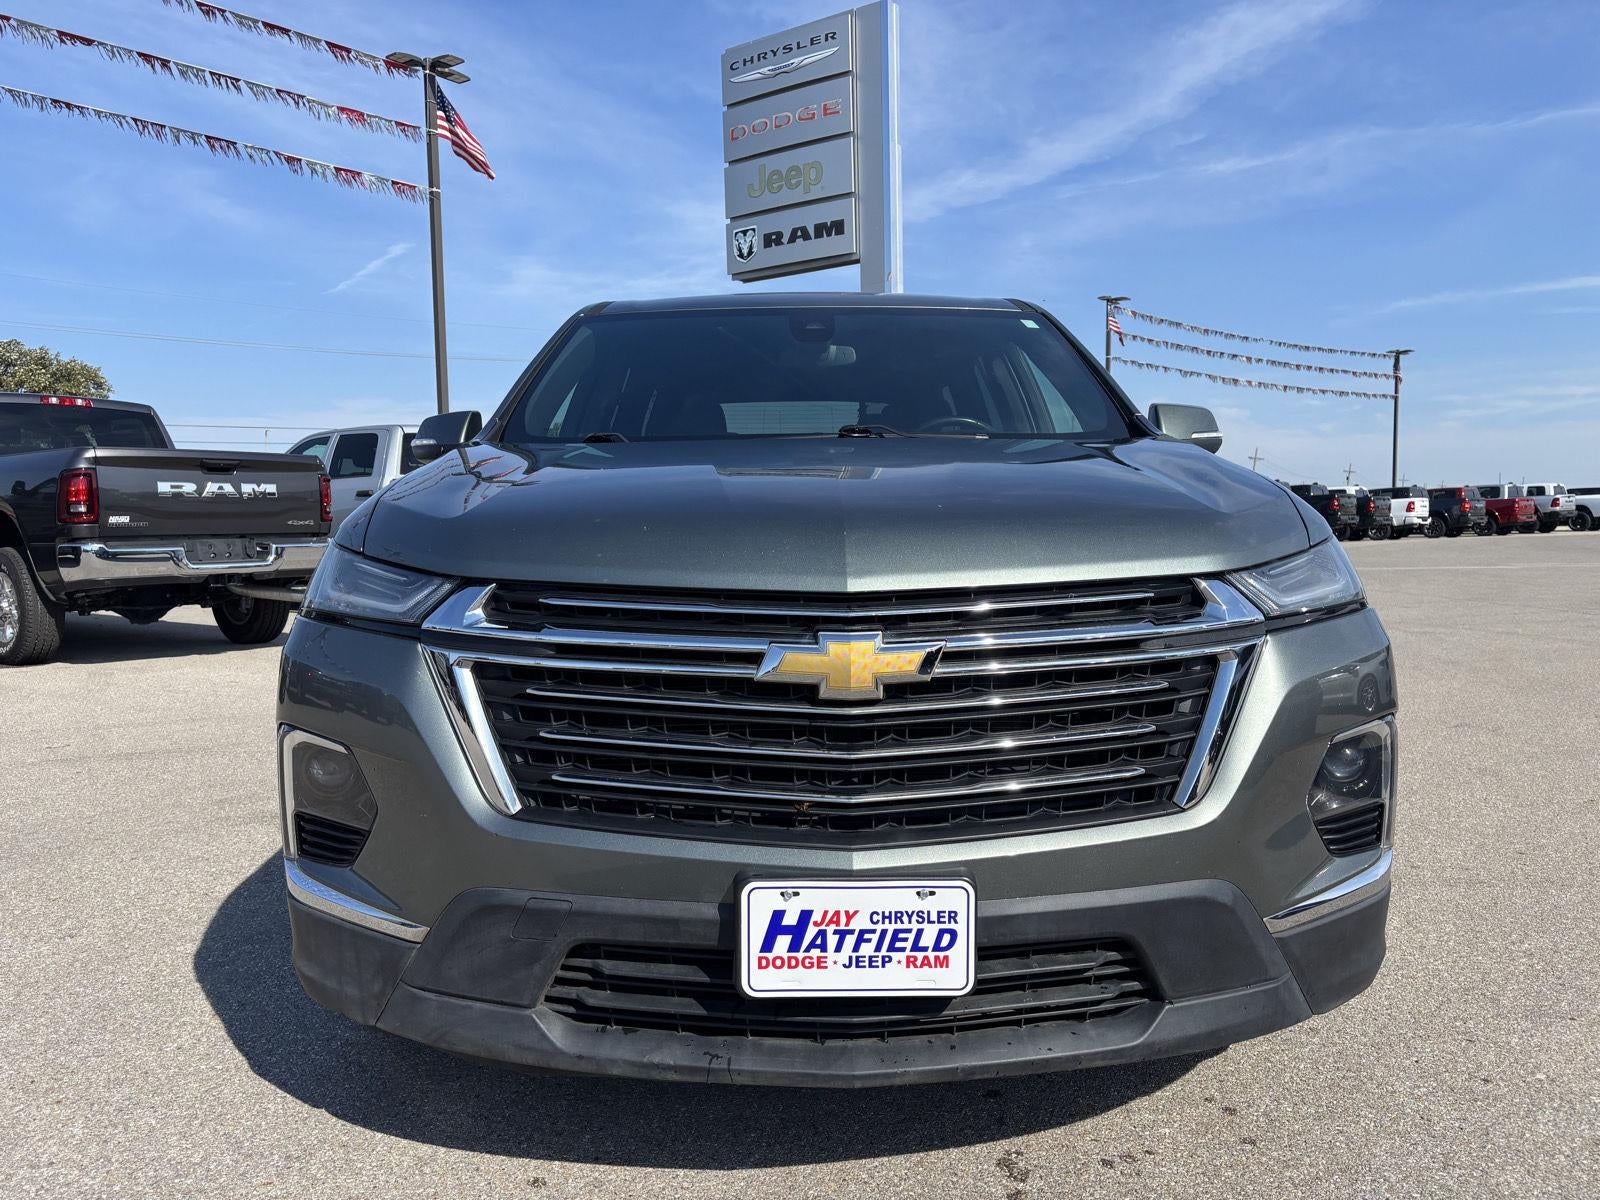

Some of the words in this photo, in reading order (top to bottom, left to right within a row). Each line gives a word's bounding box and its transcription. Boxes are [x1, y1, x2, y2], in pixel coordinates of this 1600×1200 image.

[730, 31, 837, 71] CHRYSLER
[730, 99, 842, 143] DODGE
[747, 160, 824, 198] Jeep
[763, 219, 845, 249] RAM
[157, 481, 278, 498] RAM
[759, 909, 959, 954] HATFIELD
[812, 909, 860, 928] JAY
[869, 910, 959, 925] CHRYSLER
[757, 955, 829, 970] DODGE
[842, 955, 893, 969] JEEP
[905, 955, 950, 969] RAM
